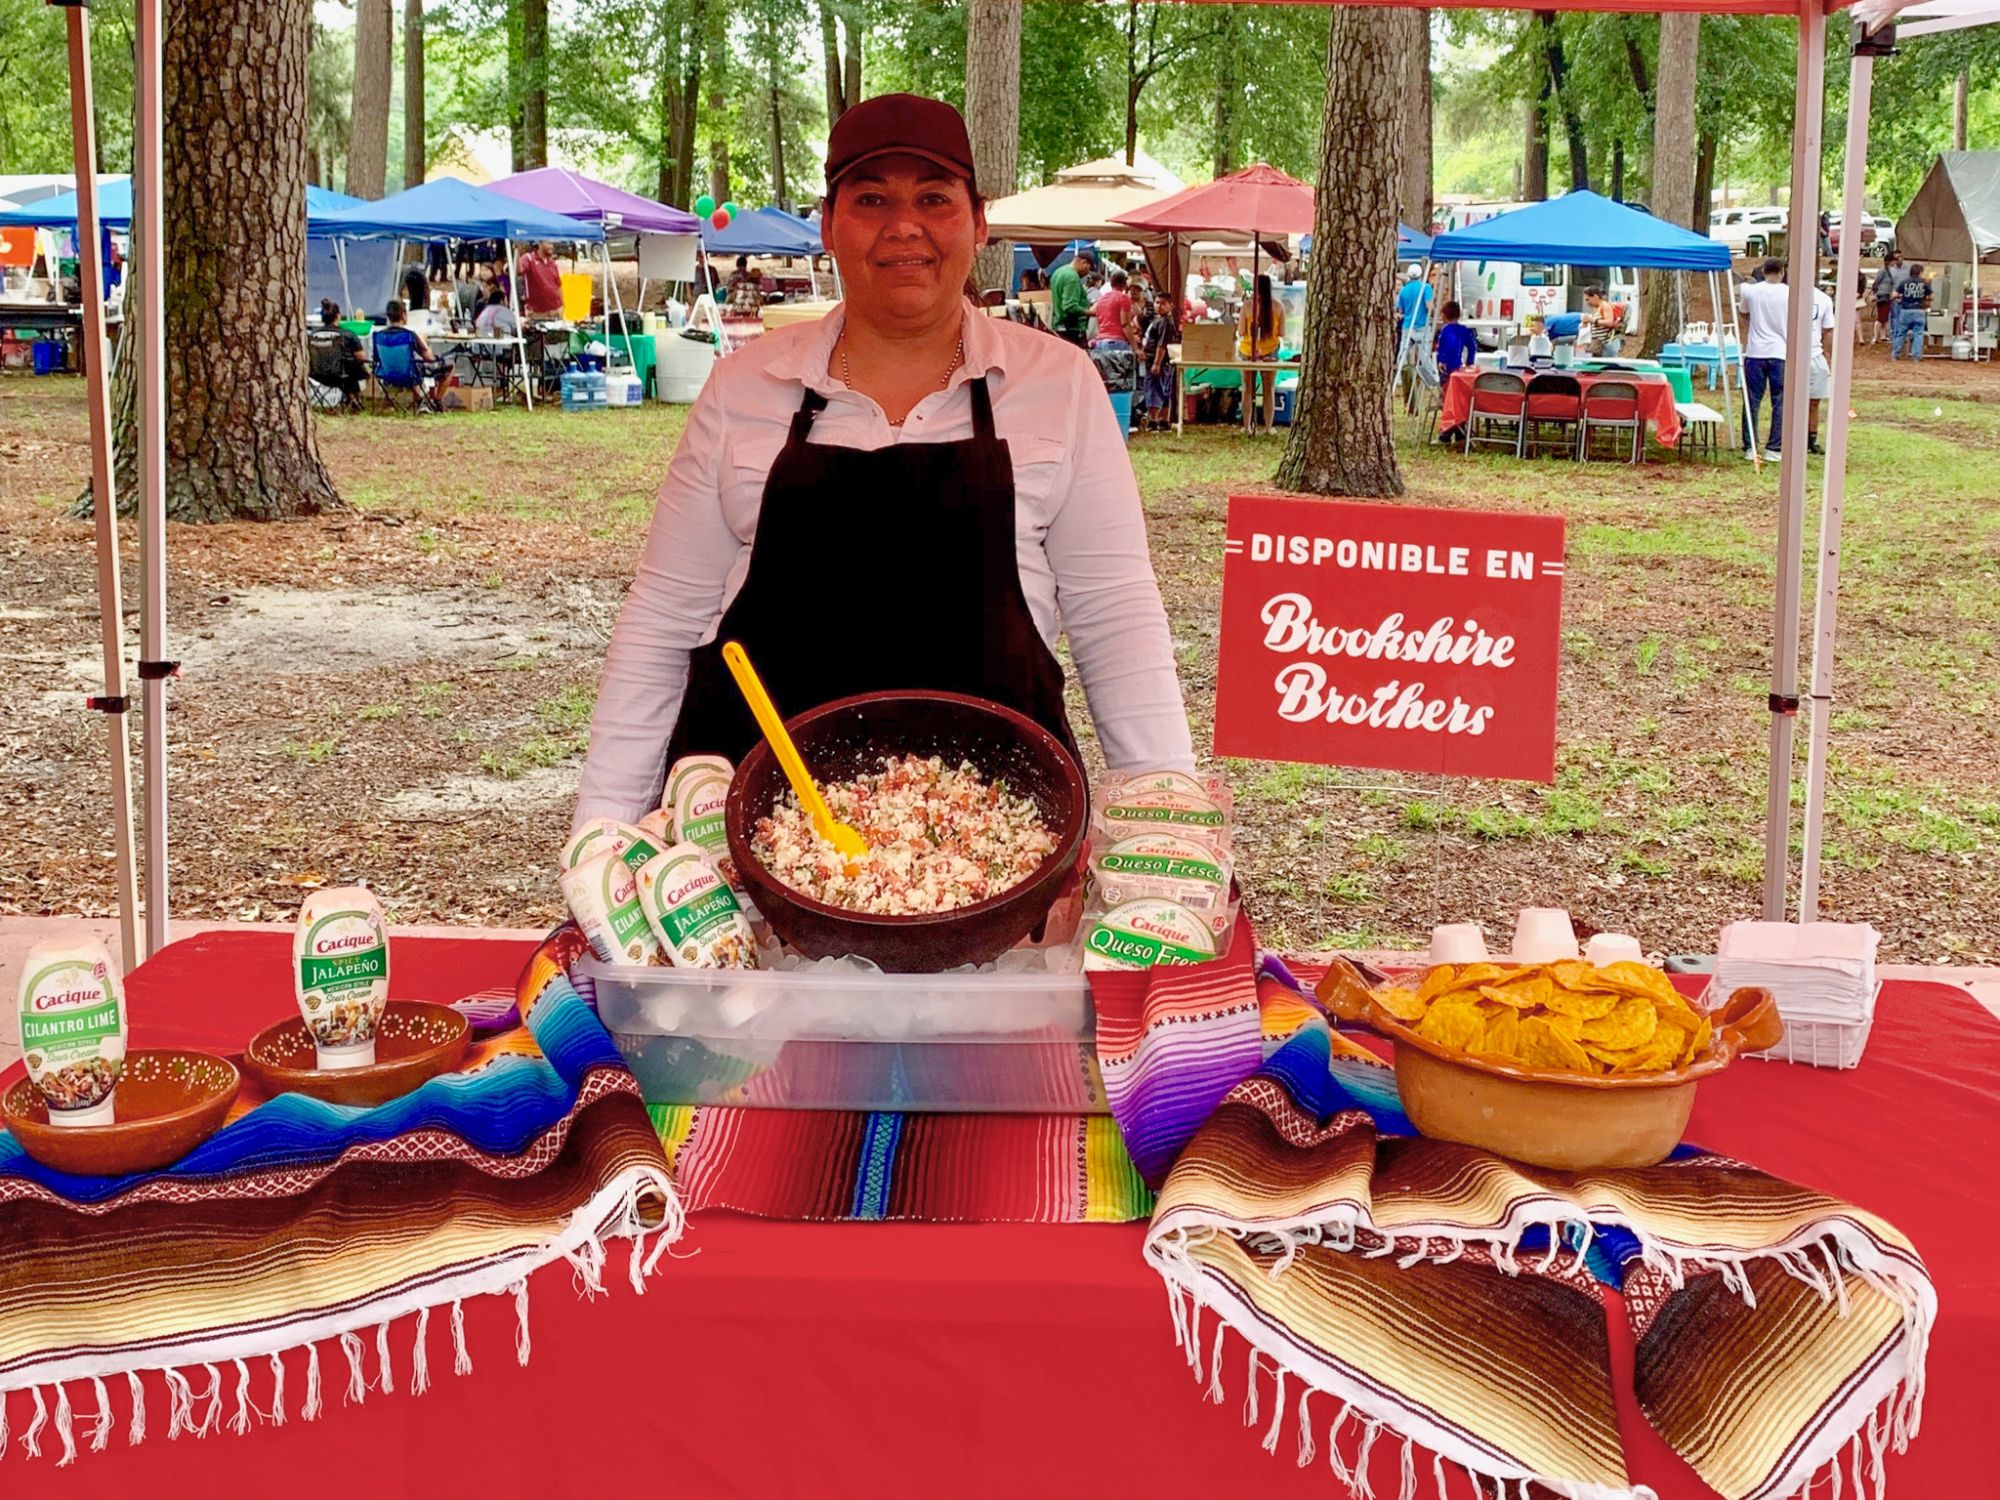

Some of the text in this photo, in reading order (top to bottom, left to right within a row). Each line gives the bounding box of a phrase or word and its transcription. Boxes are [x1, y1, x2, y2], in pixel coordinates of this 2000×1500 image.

[1251, 533, 1534, 580] DISPONIBLE EN
[1260, 593, 1516, 668] Brookshire
[1274, 661, 1495, 735] Brothers
[693, 799, 726, 816] Caci
[1106, 807, 1223, 825] Queso Fresco
[686, 821, 725, 841] CILANTR
[1135, 846, 1194, 857] Cacique
[1101, 856, 1223, 880] Queso Fresco
[667, 874, 714, 905] Cacique
[673, 895, 732, 938] JALAPEÑO
[1130, 916, 1190, 943] Cacique
[316, 935, 374, 954] Cacique
[1090, 928, 1153, 959] Queso
[311, 959, 379, 985] JALAPEÑO
[36, 989, 101, 1011] Cacique
[24, 1008, 116, 1039] CILANTRO LIME
